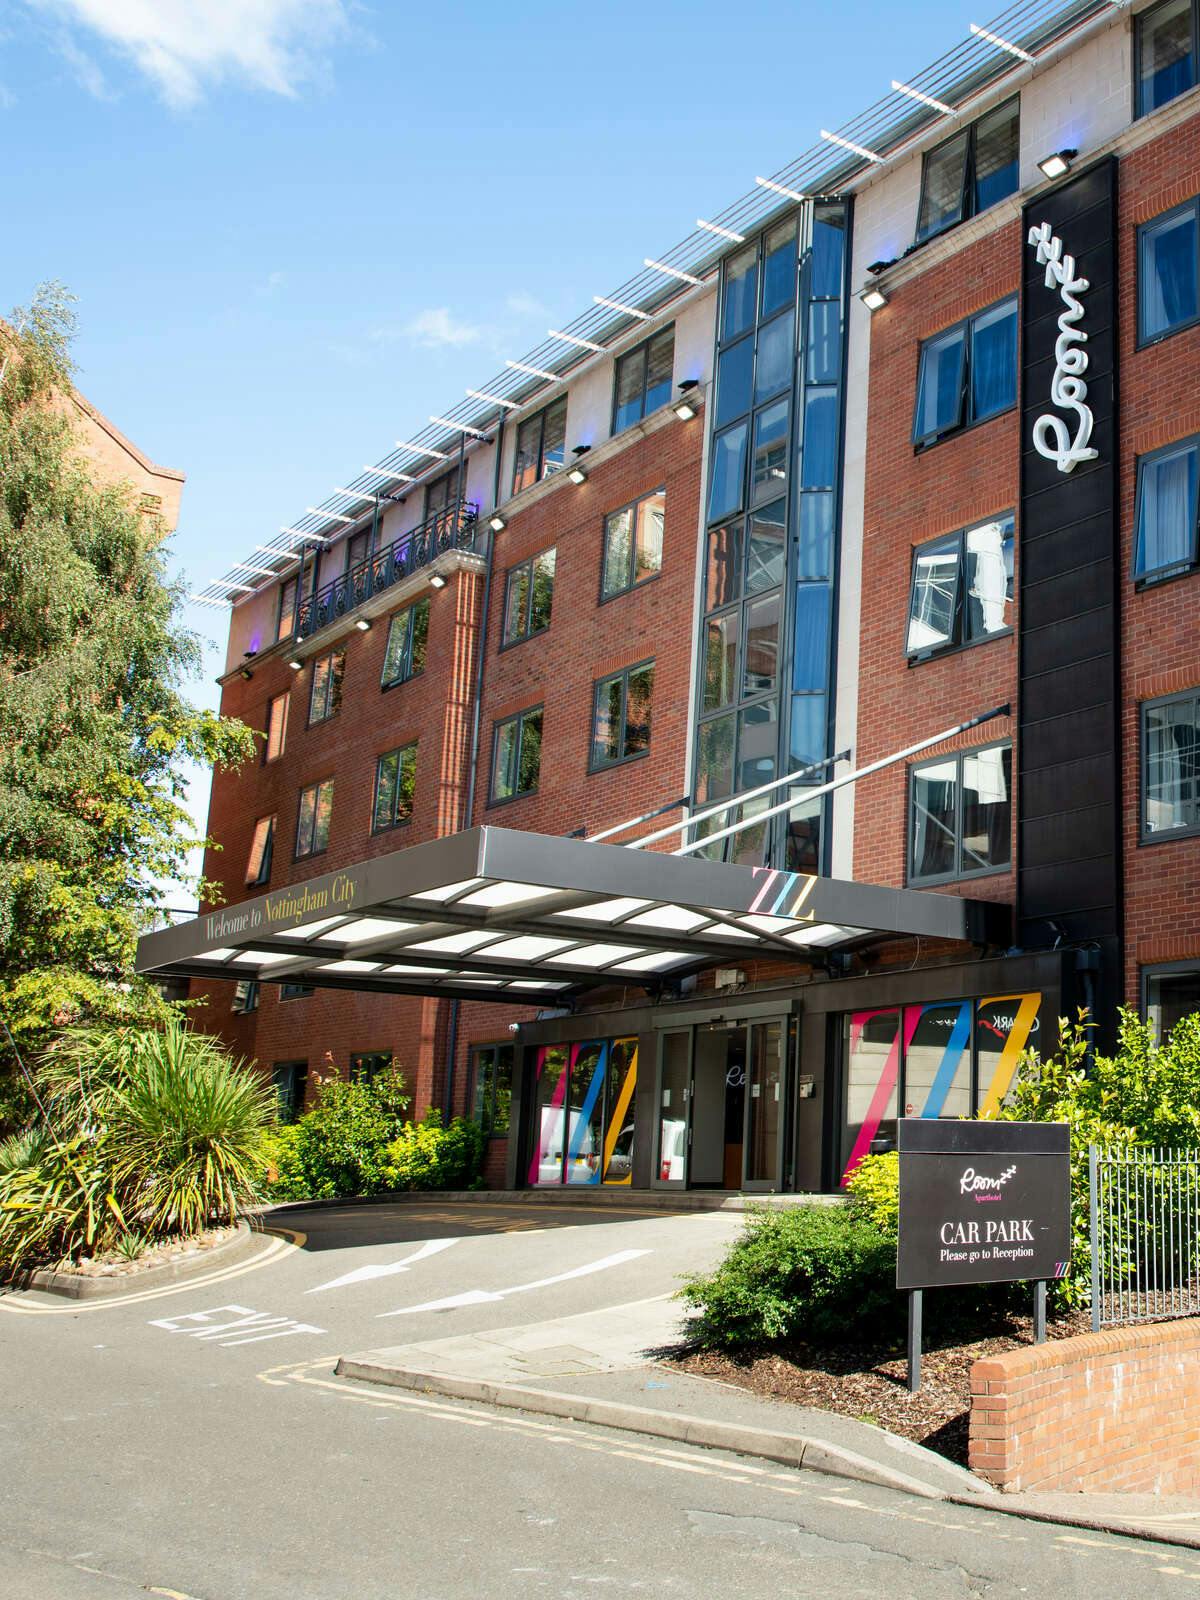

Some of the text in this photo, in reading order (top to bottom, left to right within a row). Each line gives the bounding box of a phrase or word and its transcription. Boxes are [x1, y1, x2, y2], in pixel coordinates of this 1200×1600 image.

[205, 874, 356, 941] Welcome to Nottingham City
[940, 1219, 1035, 1245] CAR PARK
[940, 1245, 1034, 1264] Please go to Reception
[146, 1304, 329, 1347] EXIT
